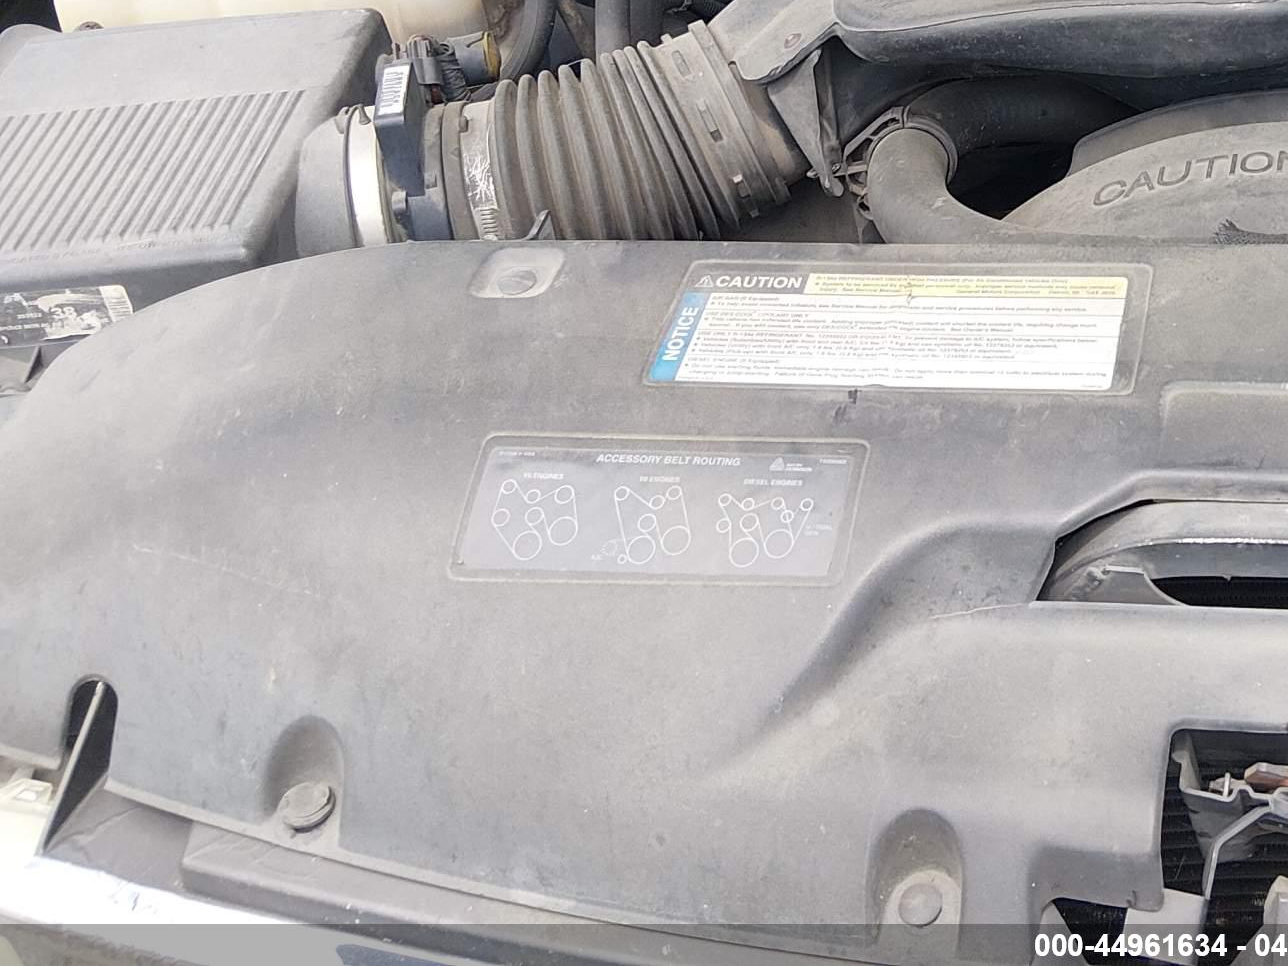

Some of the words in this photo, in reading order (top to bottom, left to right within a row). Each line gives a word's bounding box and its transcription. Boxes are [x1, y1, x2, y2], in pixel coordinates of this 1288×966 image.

[715, 276, 803, 289] CAUTION
[662, 307, 699, 361] NOTICE
[596, 453, 662, 464] ACCESSORY
[664, 455, 691, 465] BELT
[692, 456, 741, 466] ROUTING
